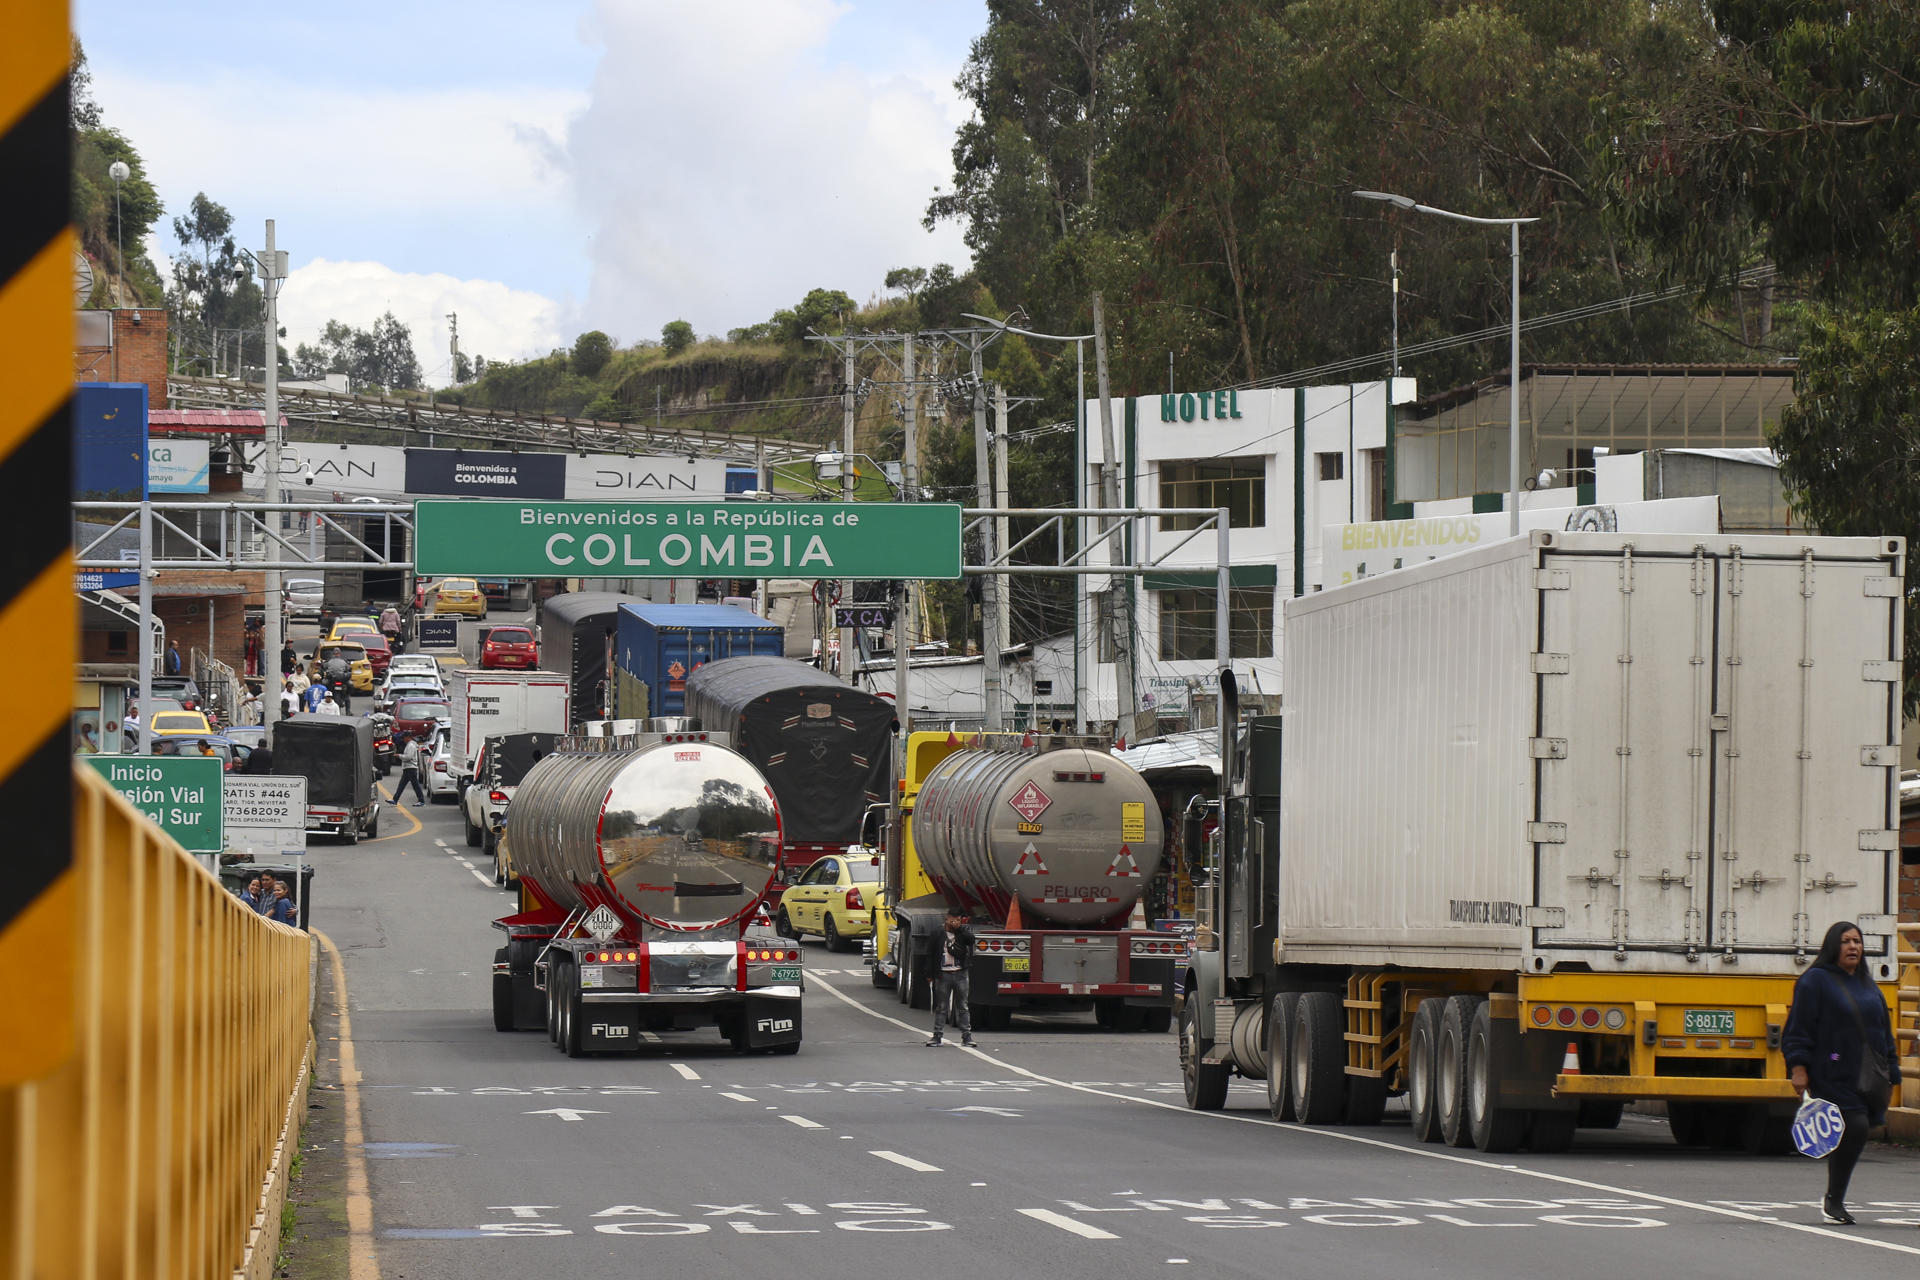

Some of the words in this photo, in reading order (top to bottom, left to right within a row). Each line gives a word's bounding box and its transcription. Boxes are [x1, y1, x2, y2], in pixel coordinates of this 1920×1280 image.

[1160, 390, 1242, 423] HOTEL
[456, 464, 510, 472] Bienvenidos
[454, 474, 518, 485] COLOMBIA
[595, 470, 696, 491] DIAN
[520, 508, 658, 526] Bienvenidos
[666, 512, 678, 526] a
[686, 508, 706, 526] la
[714, 508, 826, 530] República
[832, 510, 860, 526] de
[1342, 518, 1481, 551] BIENVENIDOS
[545, 532, 834, 568] COLOMBIA
[111, 764, 163, 782] Inicio
[170, 786, 204, 803] Vial
[170, 808, 202, 825] Sur
[1044, 886, 1112, 898] PELIGRO
[1450, 900, 1482, 923] TRANSPORTE
[1482, 902, 1490, 924] DE
[1492, 902, 1522, 927] ALIMENTOS
[1686, 1014, 1733, 1028] S-88175
[1796, 1106, 1844, 1151] SOAT
[486, 1202, 928, 1217] TAXIS
[1056, 1197, 1666, 1212] LIVIANOS
[479, 1220, 954, 1237] SOLO
[1184, 1214, 1669, 1228] SOLO
